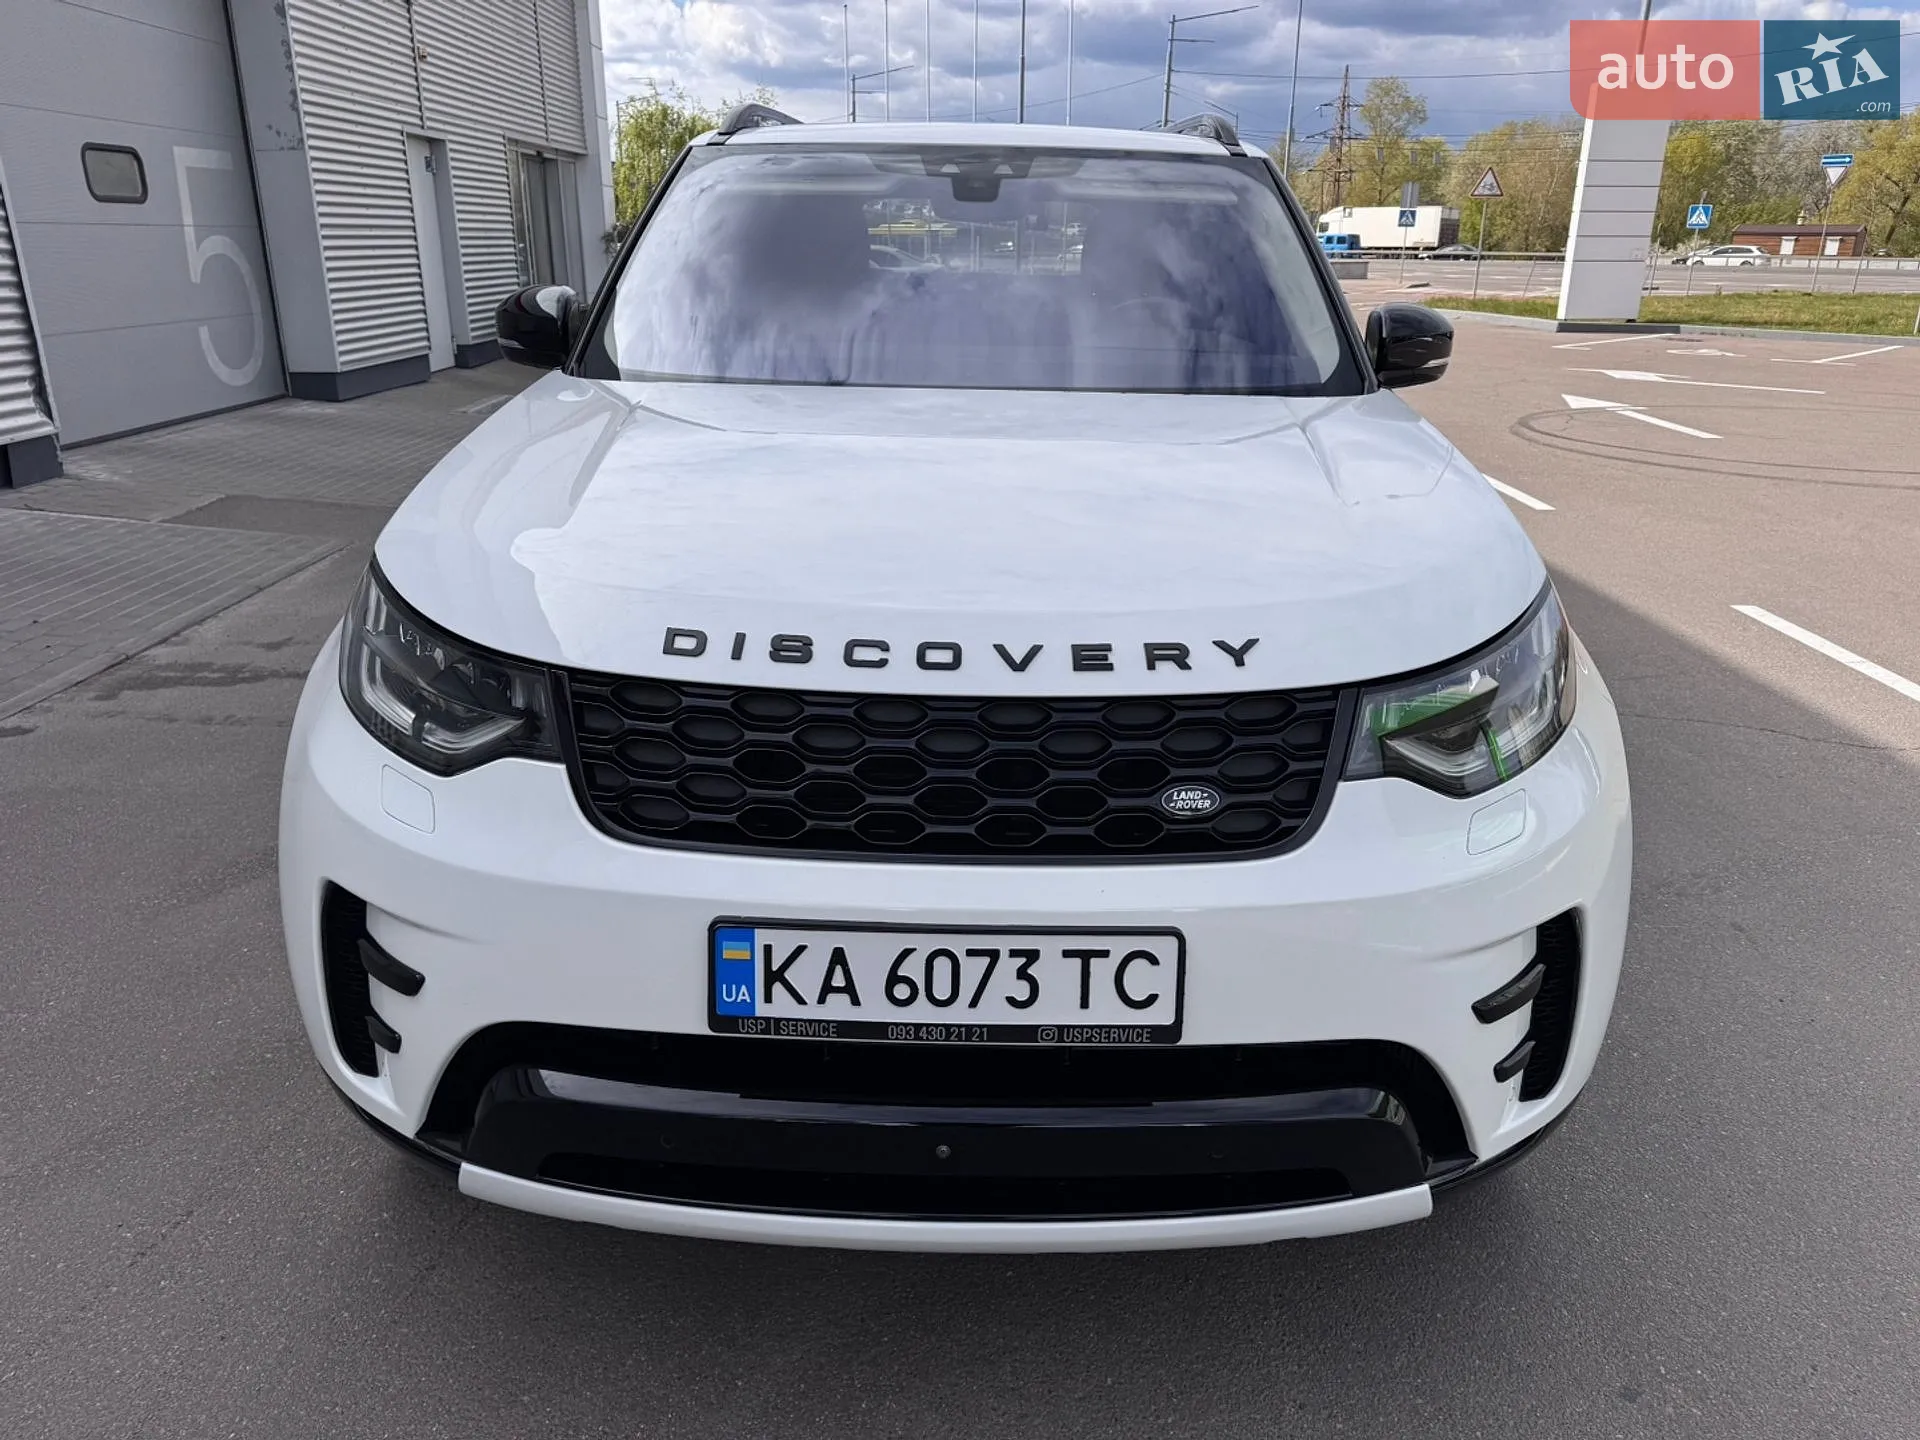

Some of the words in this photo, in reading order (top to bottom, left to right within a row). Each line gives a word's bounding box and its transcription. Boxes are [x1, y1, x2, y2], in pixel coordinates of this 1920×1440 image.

[172, 145, 264, 387] 5
[662, 626, 1260, 672] DISCOVERY
[763, 943, 862, 1007] KA
[884, 947, 1041, 1010] 6073
[1062, 949, 1160, 1010] TC
[722, 983, 751, 1003] UA
[738, 1018, 766, 1034] USP
[779, 1021, 838, 1038] SERVICE
[887, 1024, 915, 1040] 093
[919, 1025, 946, 1041] 430
[949, 1027, 967, 1041] 21
[971, 1028, 988, 1041] 21
[1063, 1028, 1152, 1043] USPSERVICE
